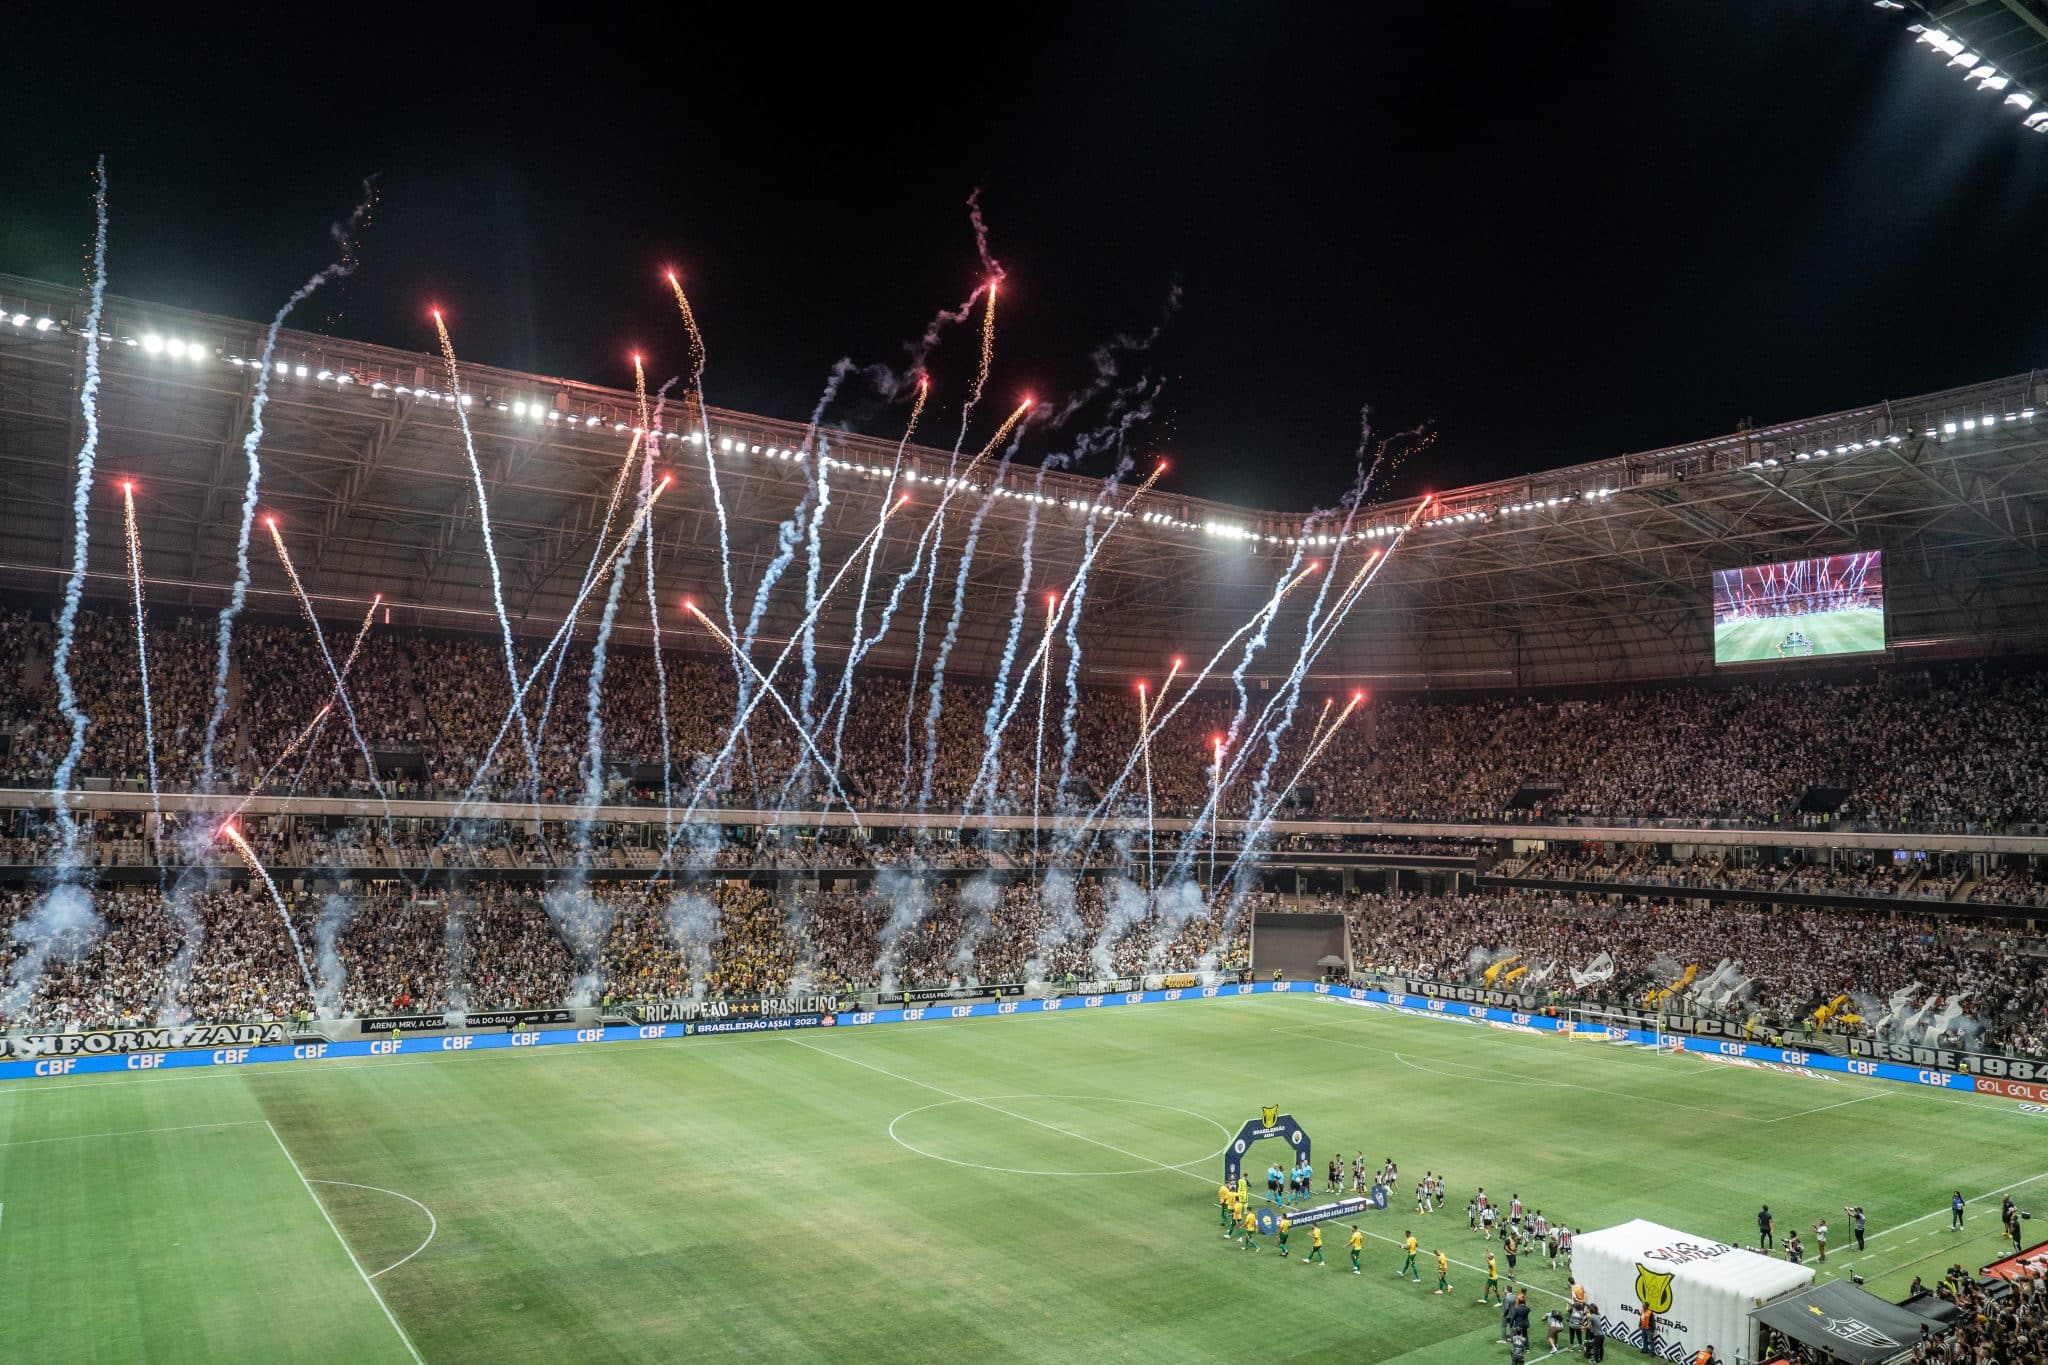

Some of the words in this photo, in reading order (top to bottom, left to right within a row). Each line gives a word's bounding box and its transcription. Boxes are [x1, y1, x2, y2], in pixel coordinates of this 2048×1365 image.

[1202, 986, 1219, 998] CBF
[1238, 983, 1254, 995] CBF
[1272, 981, 1290, 993] CBF
[1314, 983, 1330, 994] CBF
[1350, 988, 1367, 1000] CBF
[1407, 980, 1522, 1007] TORCIDA
[1085, 996, 1103, 1008] CBF
[1126, 993, 1144, 1004] CBF
[1165, 989, 1182, 1001] CBF
[1388, 993, 1405, 1006] CBF
[951, 1005, 973, 1018] CBF
[998, 1002, 1018, 1014] CBF
[1043, 999, 1063, 1011] CBF
[1428, 999, 1446, 1012] CBF
[853, 1012, 876, 1025] CBF
[903, 1008, 926, 1021] CBF
[1469, 1006, 1488, 1019] CBF
[1512, 1012, 1532, 1026] CBF
[370, 1022, 397, 1030] ARENA
[399, 1020, 418, 1030] MRV,
[419, 1020, 425, 1028] A
[425, 1018, 446, 1027] CASA
[482, 1017, 494, 1025] DO
[495, 1015, 516, 1024] GALO
[697, 1021, 766, 1033] BRASILEIRÃO
[767, 1018, 791, 1030] ASSAÍ
[794, 1017, 817, 1026] 2023
[1556, 1019, 1578, 1033] CBF
[511, 1032, 541, 1046] CBF
[577, 1028, 605, 1042] CBF
[639, 1025, 667, 1039] CBF
[1605, 1028, 1629, 1041] CBF
[370, 1040, 402, 1055] CBF
[442, 1036, 473, 1050] CBF
[1660, 1034, 1686, 1050] CBF
[1720, 1041, 1747, 1057] CBF
[213, 1049, 249, 1065] CBF
[294, 1044, 328, 1059] CBF
[1782, 1050, 1810, 1066] CBF
[1850, 1038, 1956, 1069] DESDE
[35, 1058, 77, 1076] CBF
[127, 1053, 166, 1070] CBF
[1847, 1060, 1878, 1076] CBF
[1919, 1070, 1952, 1087] CBF
[1976, 1079, 2003, 1094] GOL
[2007, 1084, 2035, 1098] GOL
[1293, 1211, 1331, 1225] BRASILEIRÃO
[1344, 1205, 1358, 1214] 2023
[1620, 1303, 1688, 1333] BRAEIRÃO
[1836, 1322, 1864, 1336] CAM
